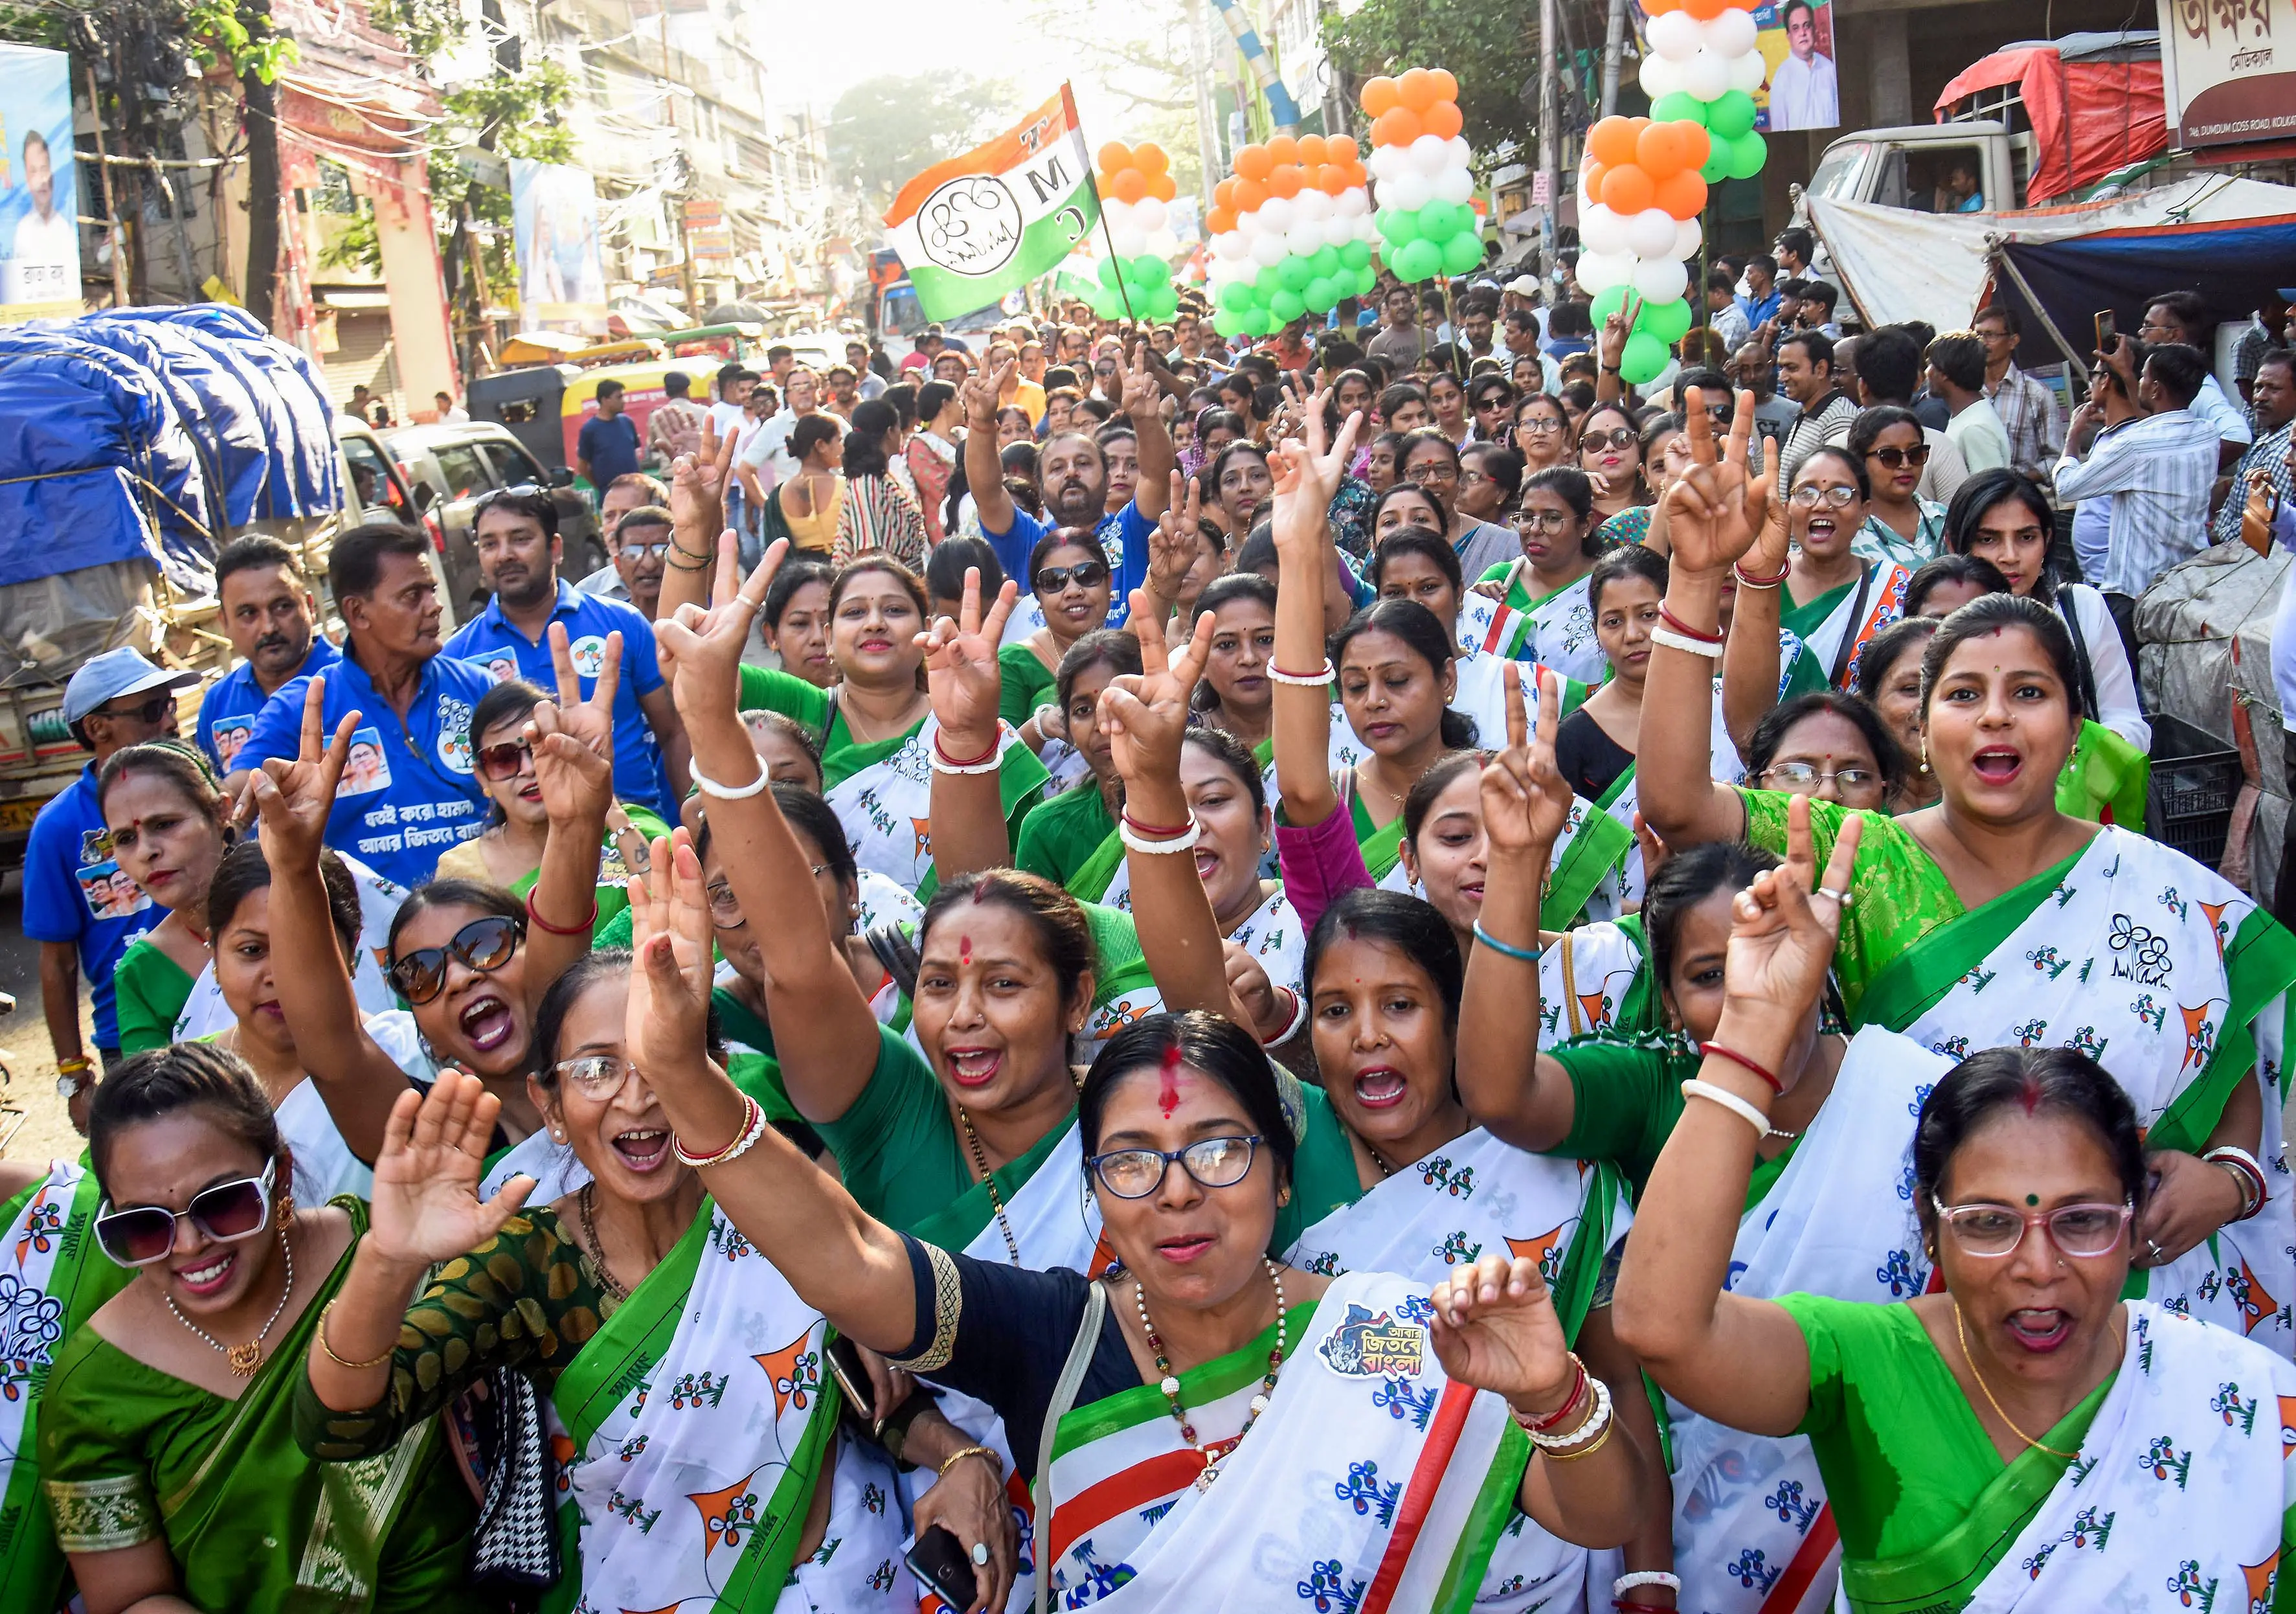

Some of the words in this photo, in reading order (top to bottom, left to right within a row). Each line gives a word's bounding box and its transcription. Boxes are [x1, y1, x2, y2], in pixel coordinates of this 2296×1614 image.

[357, 834, 402, 854] আবার
[404, 826, 454, 848] জিতবে
[1361, 1329, 1422, 1354] জিতবে
[1388, 1328, 1422, 1339] আবার
[1362, 1353, 1422, 1376] বাংলা
